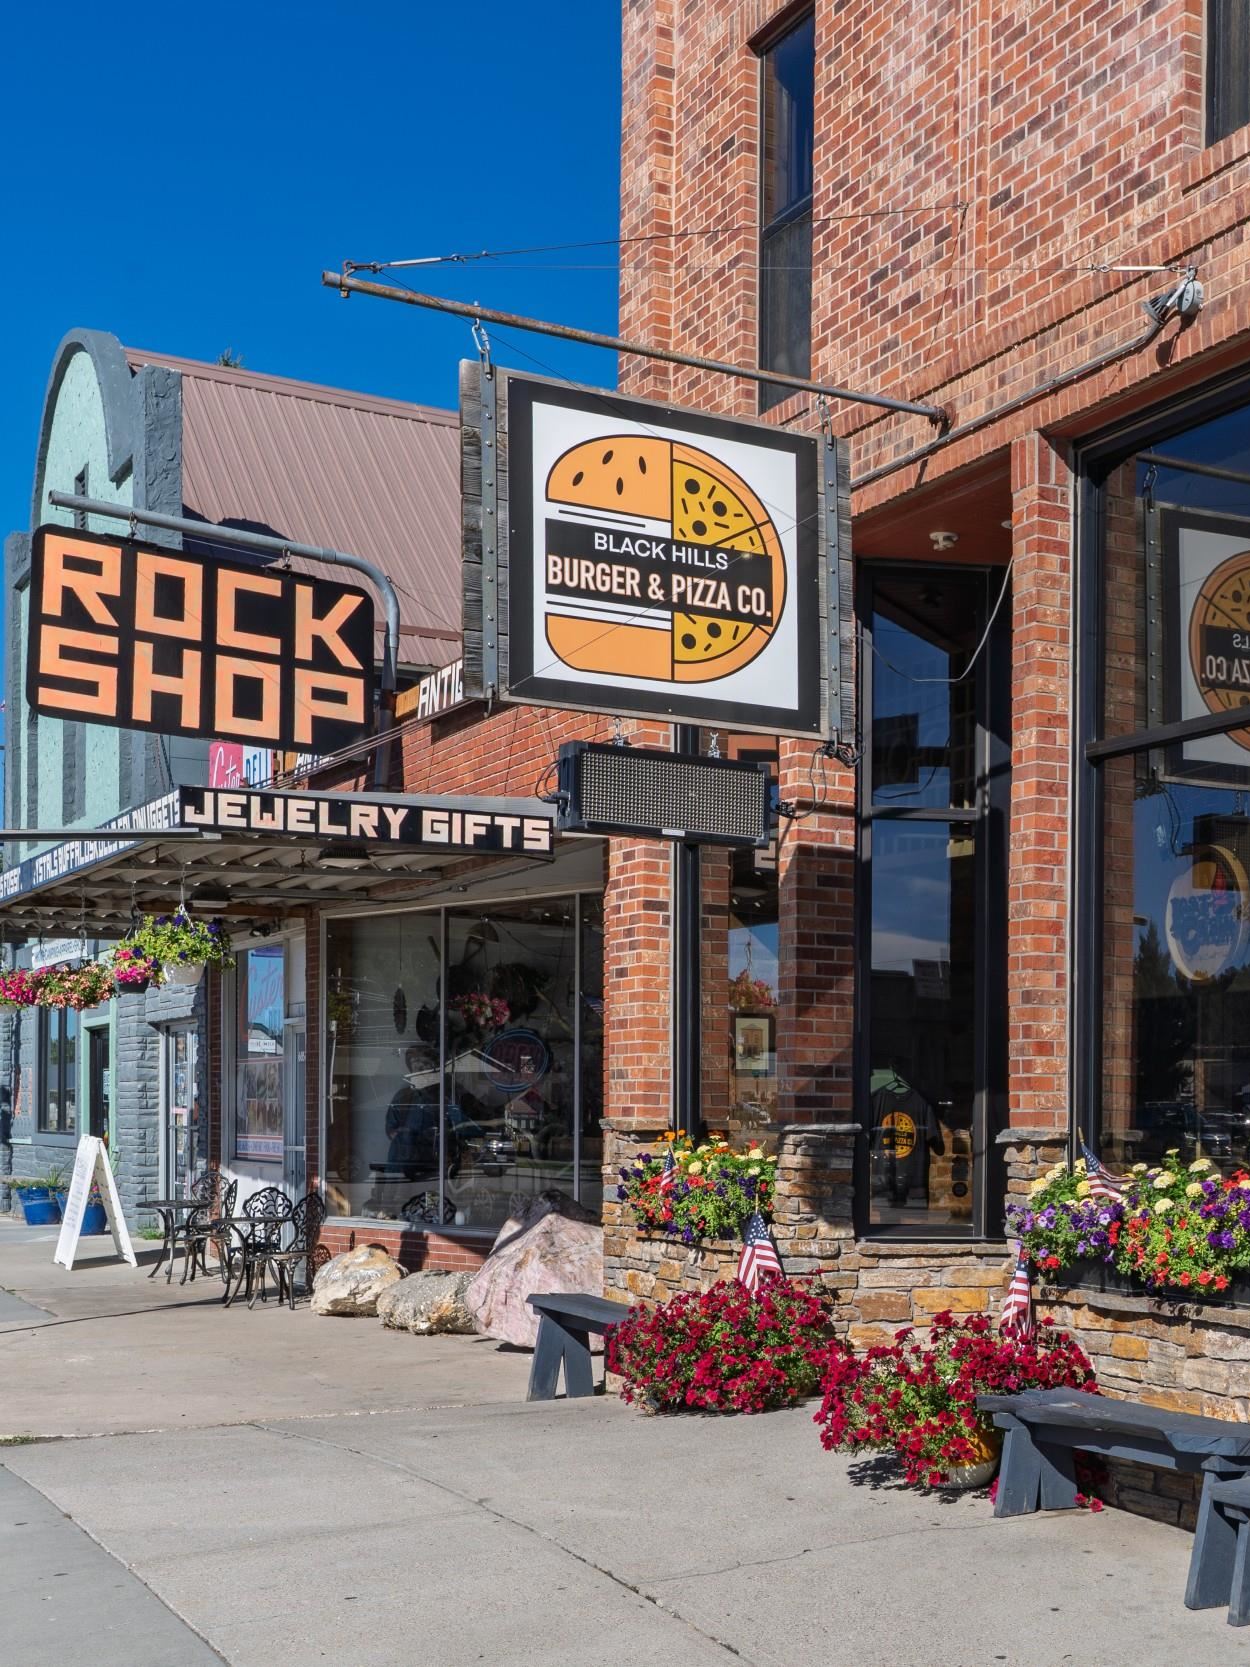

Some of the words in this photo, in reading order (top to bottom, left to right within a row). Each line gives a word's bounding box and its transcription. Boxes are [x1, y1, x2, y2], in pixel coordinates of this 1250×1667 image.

[594, 532, 666, 560] BLACK
[672, 545, 728, 570] HILLS
[41, 533, 364, 669] ROCK
[547, 554, 642, 598] BURGER
[648, 573, 665, 601] &
[671, 573, 732, 612] PIZZA
[737, 585, 772, 618] CO.
[37, 624, 364, 744] SHOP
[184, 791, 408, 840] JEWELRY
[422, 810, 550, 850] GIFTS
